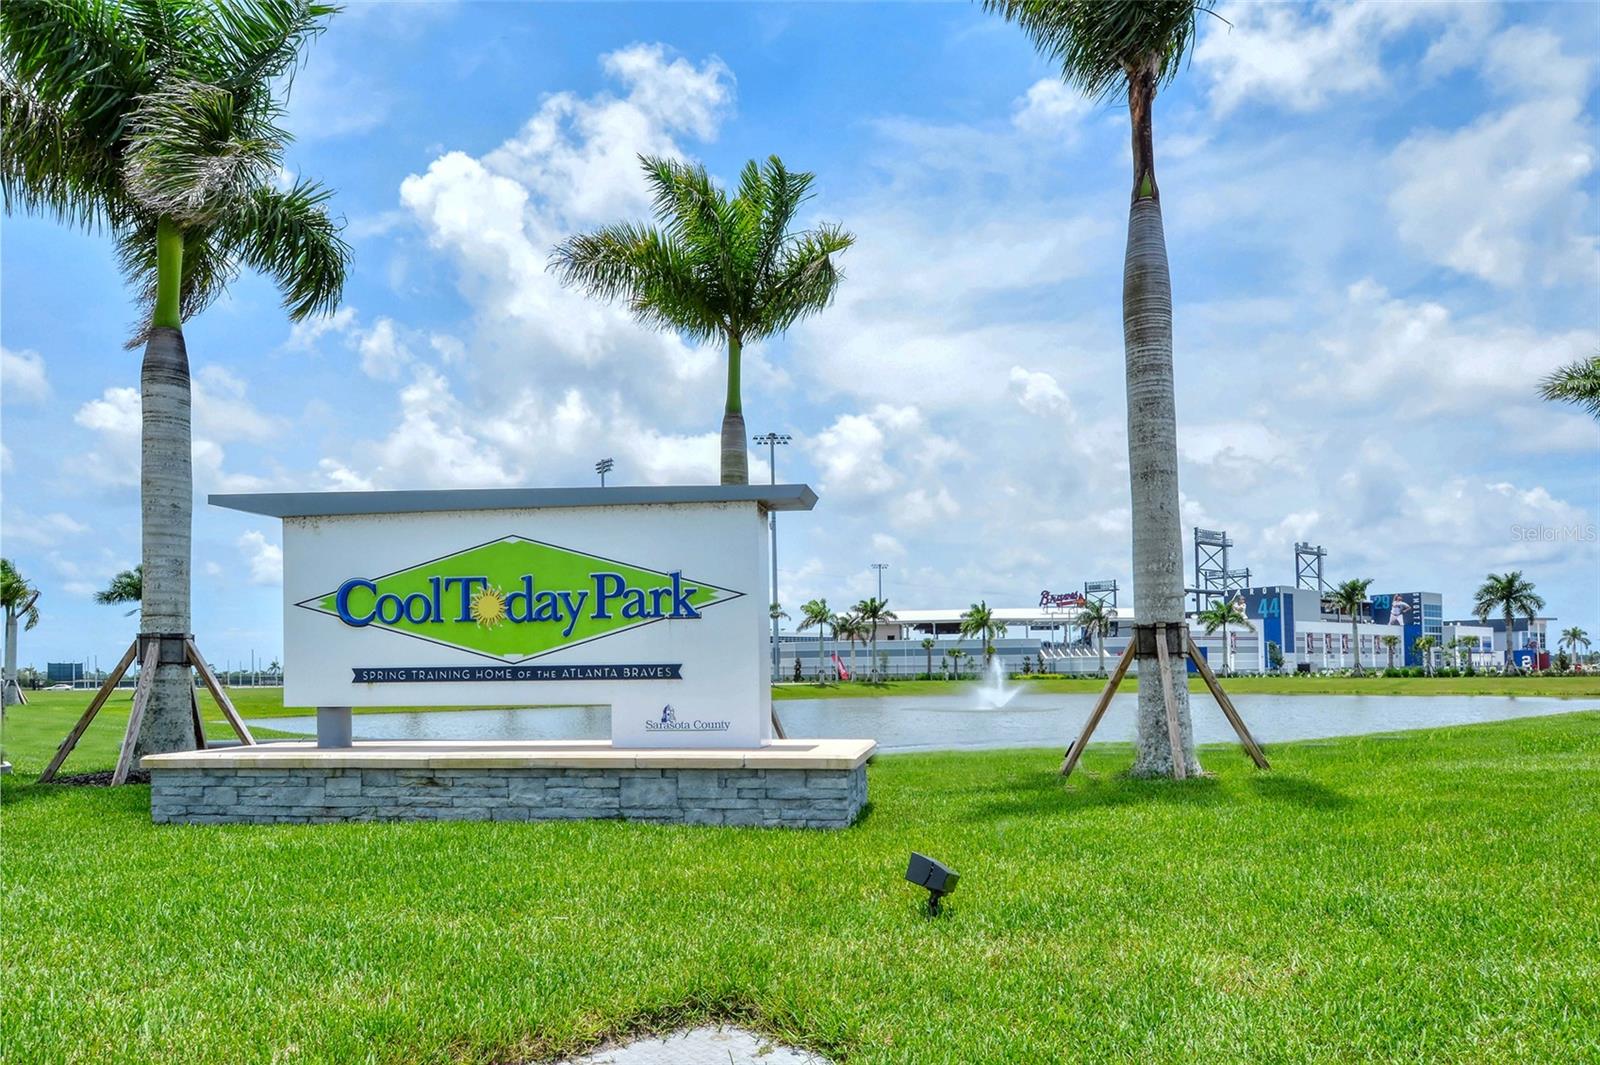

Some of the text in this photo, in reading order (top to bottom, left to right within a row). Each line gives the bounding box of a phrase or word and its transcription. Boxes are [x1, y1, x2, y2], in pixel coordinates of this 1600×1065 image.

[1039, 590, 1079, 607] Braves
[1375, 596, 1389, 609] 29
[1258, 597, 1280, 618] 44
[362, 666, 672, 681] SPRING TRAINING HOME OF THE ATLANTA BRAVES
[645, 719, 731, 730] Sarasota County
